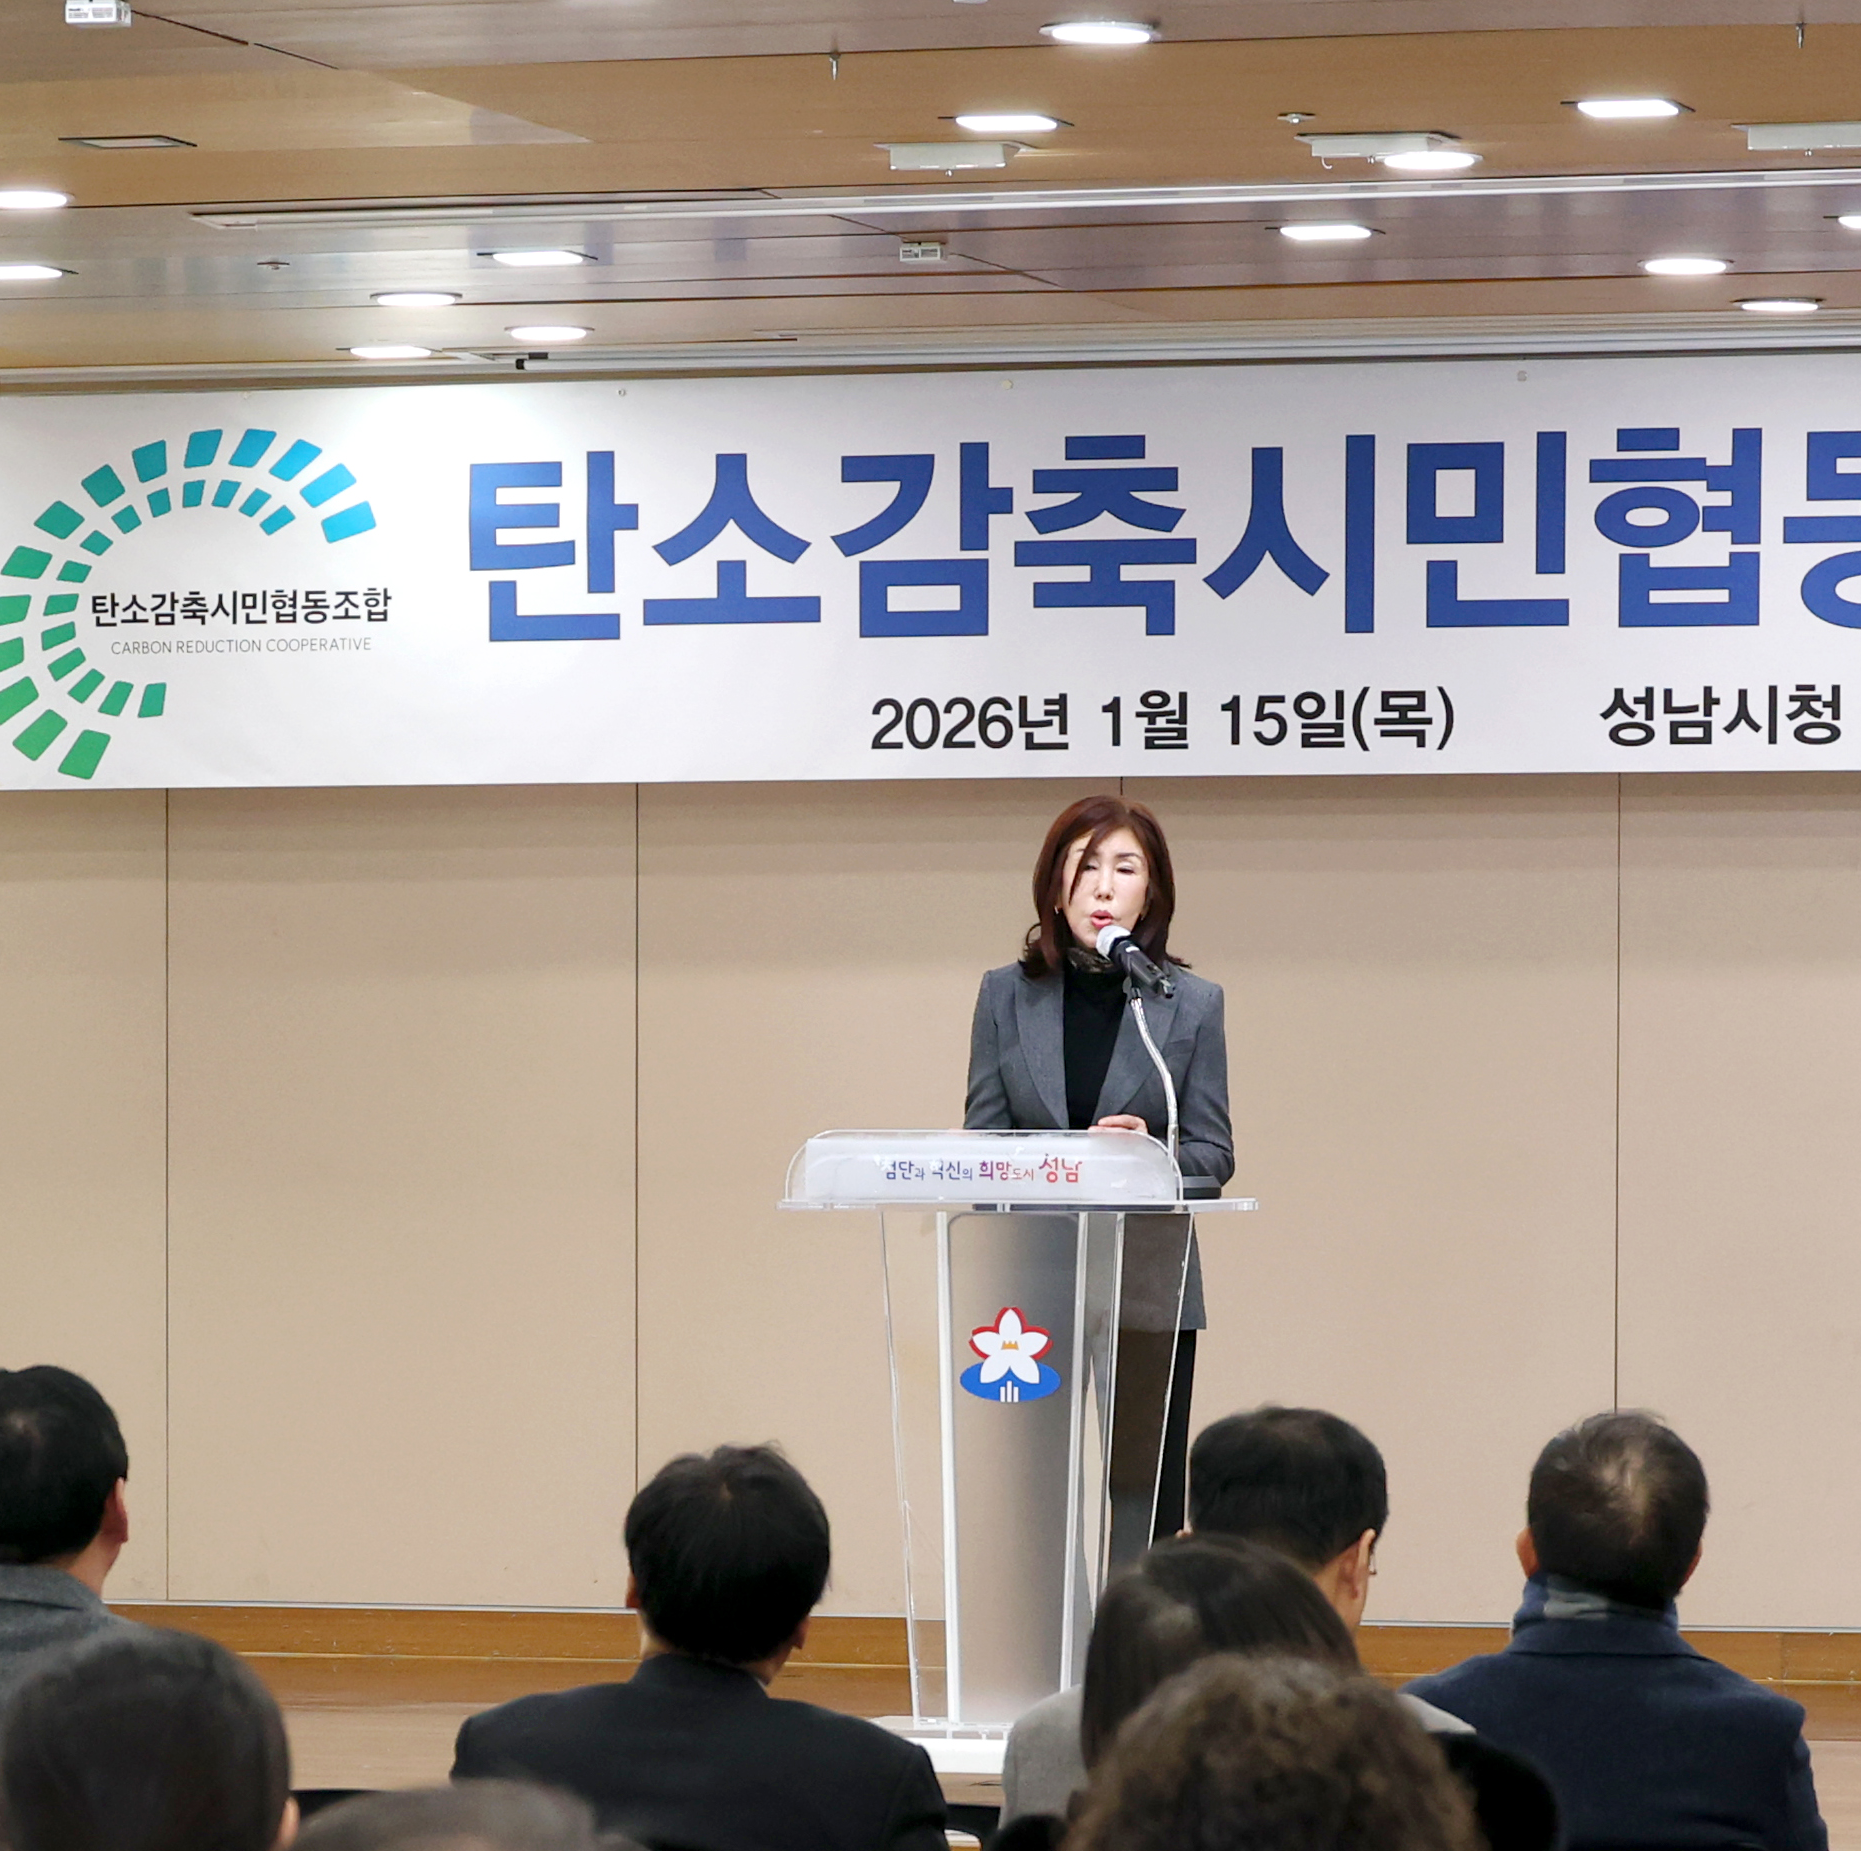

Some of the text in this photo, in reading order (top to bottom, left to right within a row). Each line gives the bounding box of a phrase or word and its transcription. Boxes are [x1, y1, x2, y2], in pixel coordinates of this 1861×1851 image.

[91, 587, 392, 627] 탄소감축시민협동조합
[110, 637, 371, 655] CARBON REDUCTION COOPERATIVE
[871, 687, 1454, 752] 2026년 1월 15일(목)
[1600, 685, 1841, 747] 성남시청
[1039, 1153, 1083, 1183] 성남
